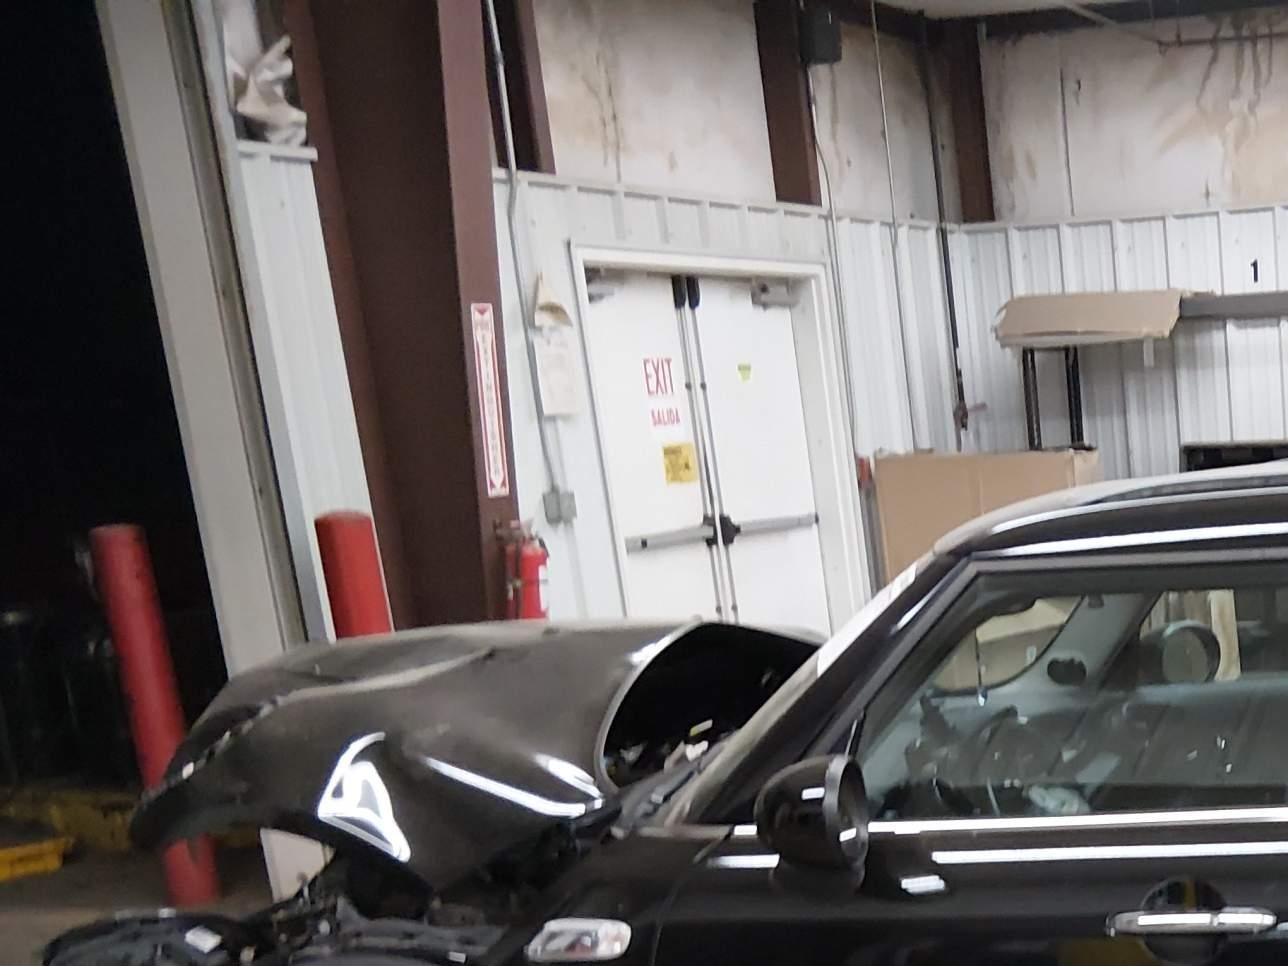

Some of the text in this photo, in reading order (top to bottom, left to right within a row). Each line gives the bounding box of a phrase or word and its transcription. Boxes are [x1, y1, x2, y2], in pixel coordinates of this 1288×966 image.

[1250, 258, 1259, 284] 1
[643, 358, 674, 396] EXIT
[651, 408, 681, 427] SALIDA
